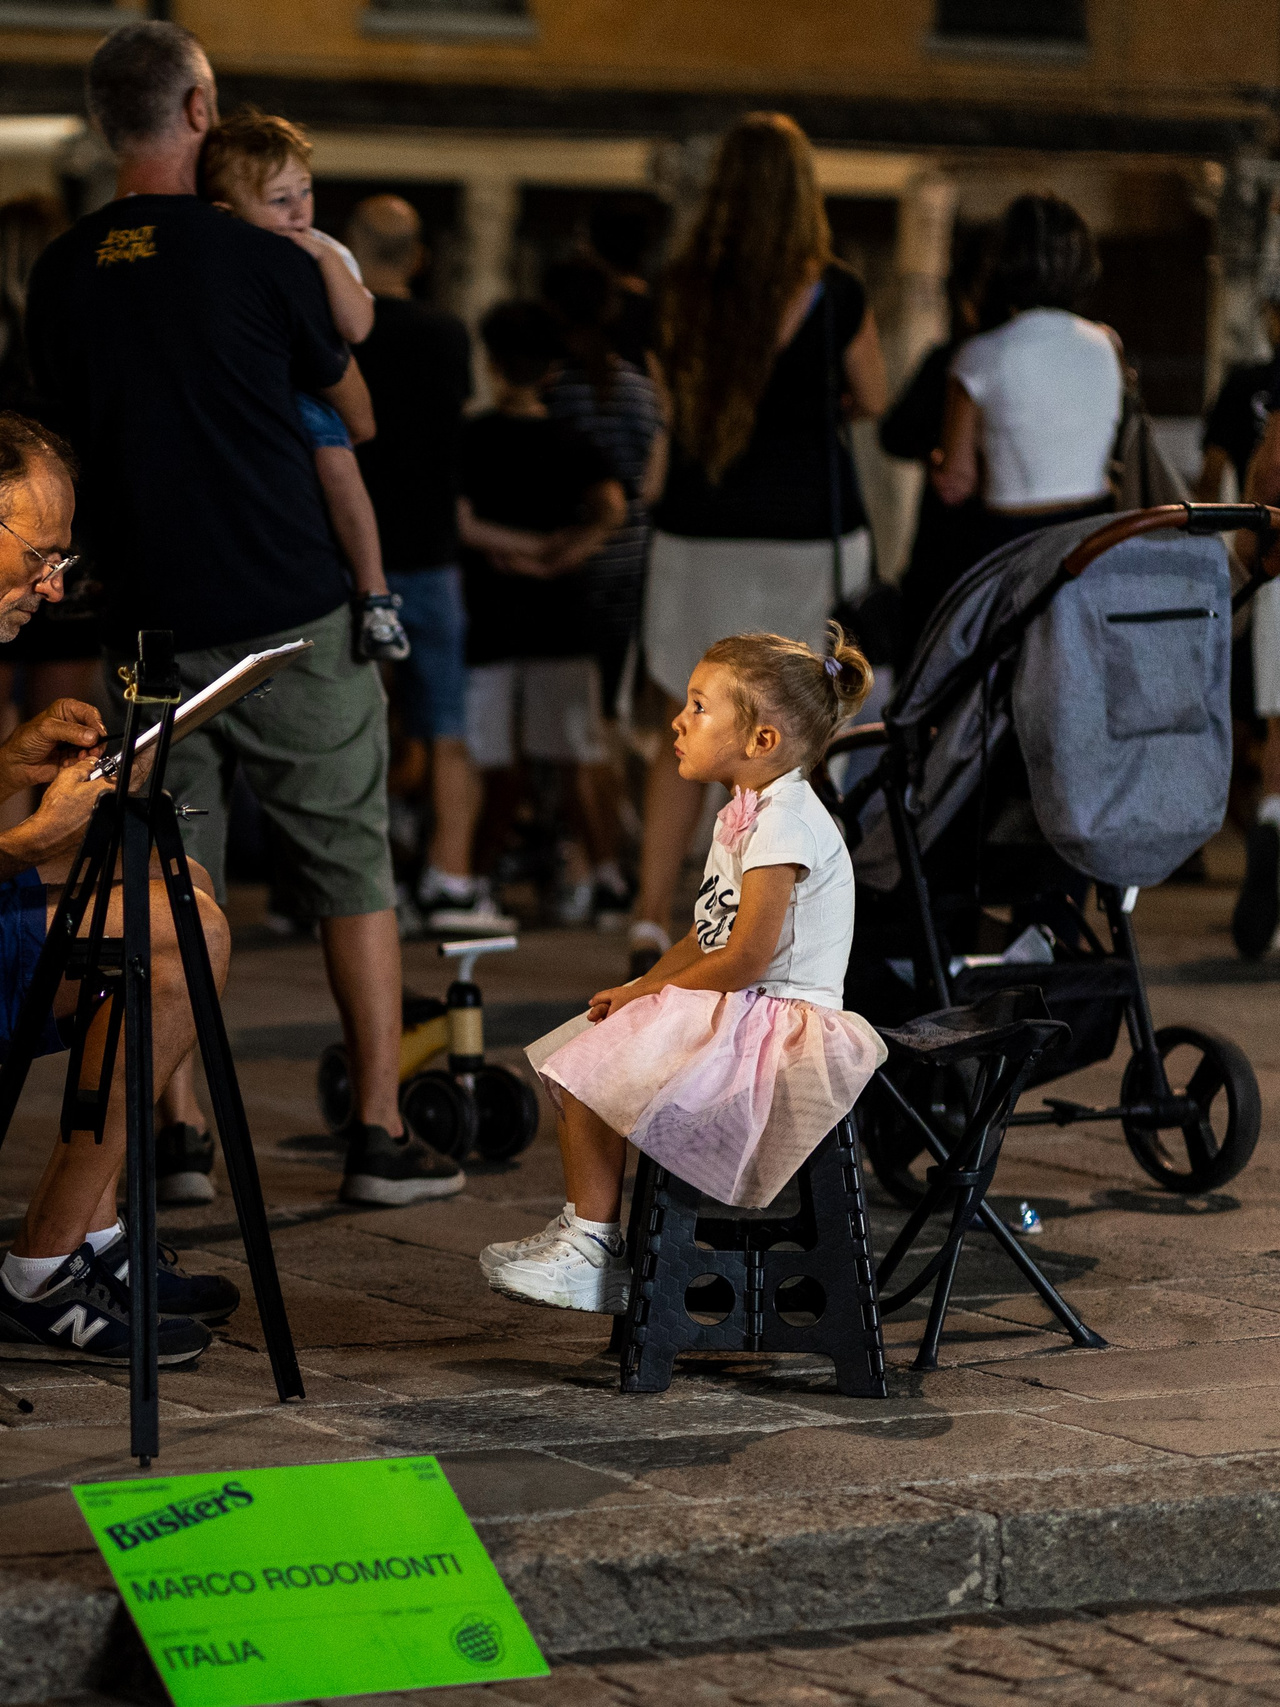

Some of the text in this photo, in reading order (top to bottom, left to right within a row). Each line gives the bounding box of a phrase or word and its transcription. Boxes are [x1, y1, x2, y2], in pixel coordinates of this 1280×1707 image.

[48, 1303, 110, 1349] N
[105, 1480, 254, 1551] BuskerS
[131, 1553, 463, 1602] MARCO RODOMONTI
[162, 1639, 266, 1671] ITALIA
